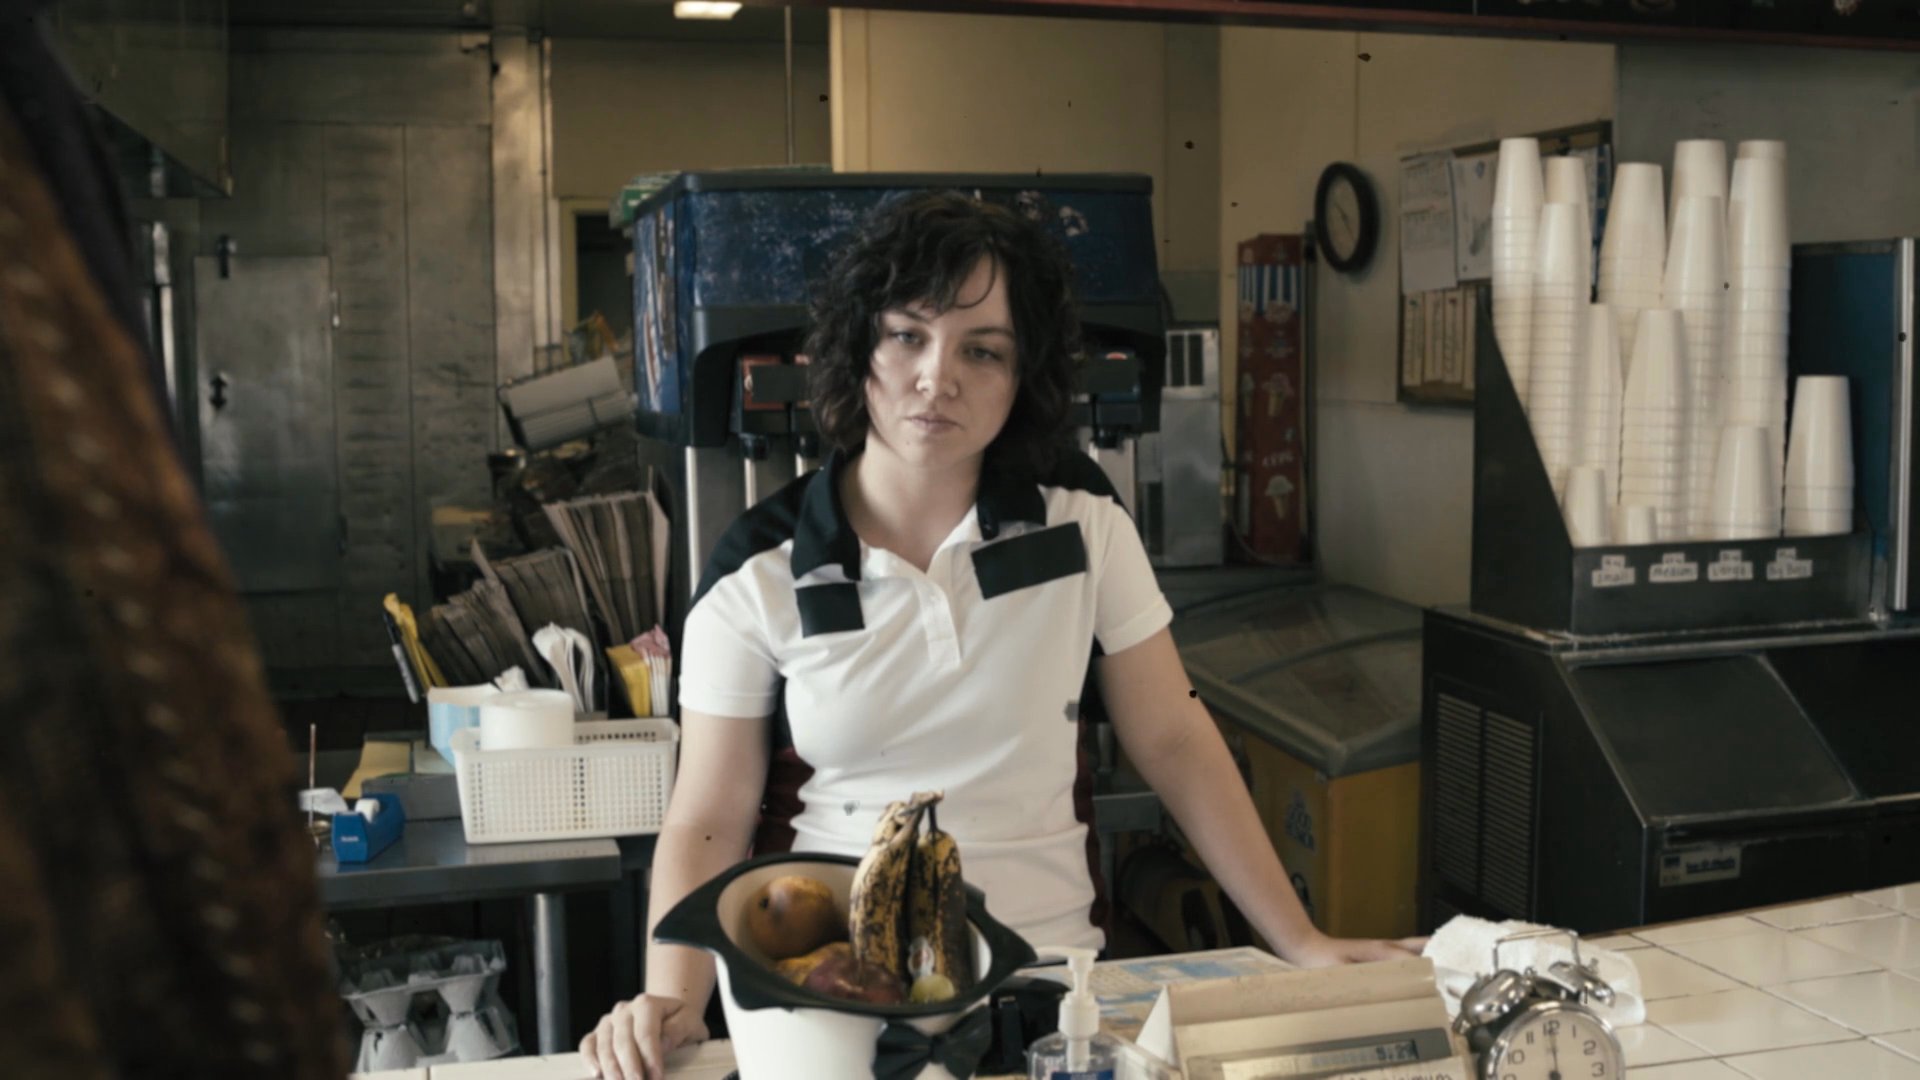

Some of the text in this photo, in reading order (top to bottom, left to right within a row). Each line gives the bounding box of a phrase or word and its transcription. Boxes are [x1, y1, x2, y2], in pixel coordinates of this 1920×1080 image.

[1543, 1020, 1560, 1036] 12
[1583, 1040, 1597, 1056] 2
[1507, 1049, 1526, 1065] 10
[1591, 1062, 1605, 1078] 3
